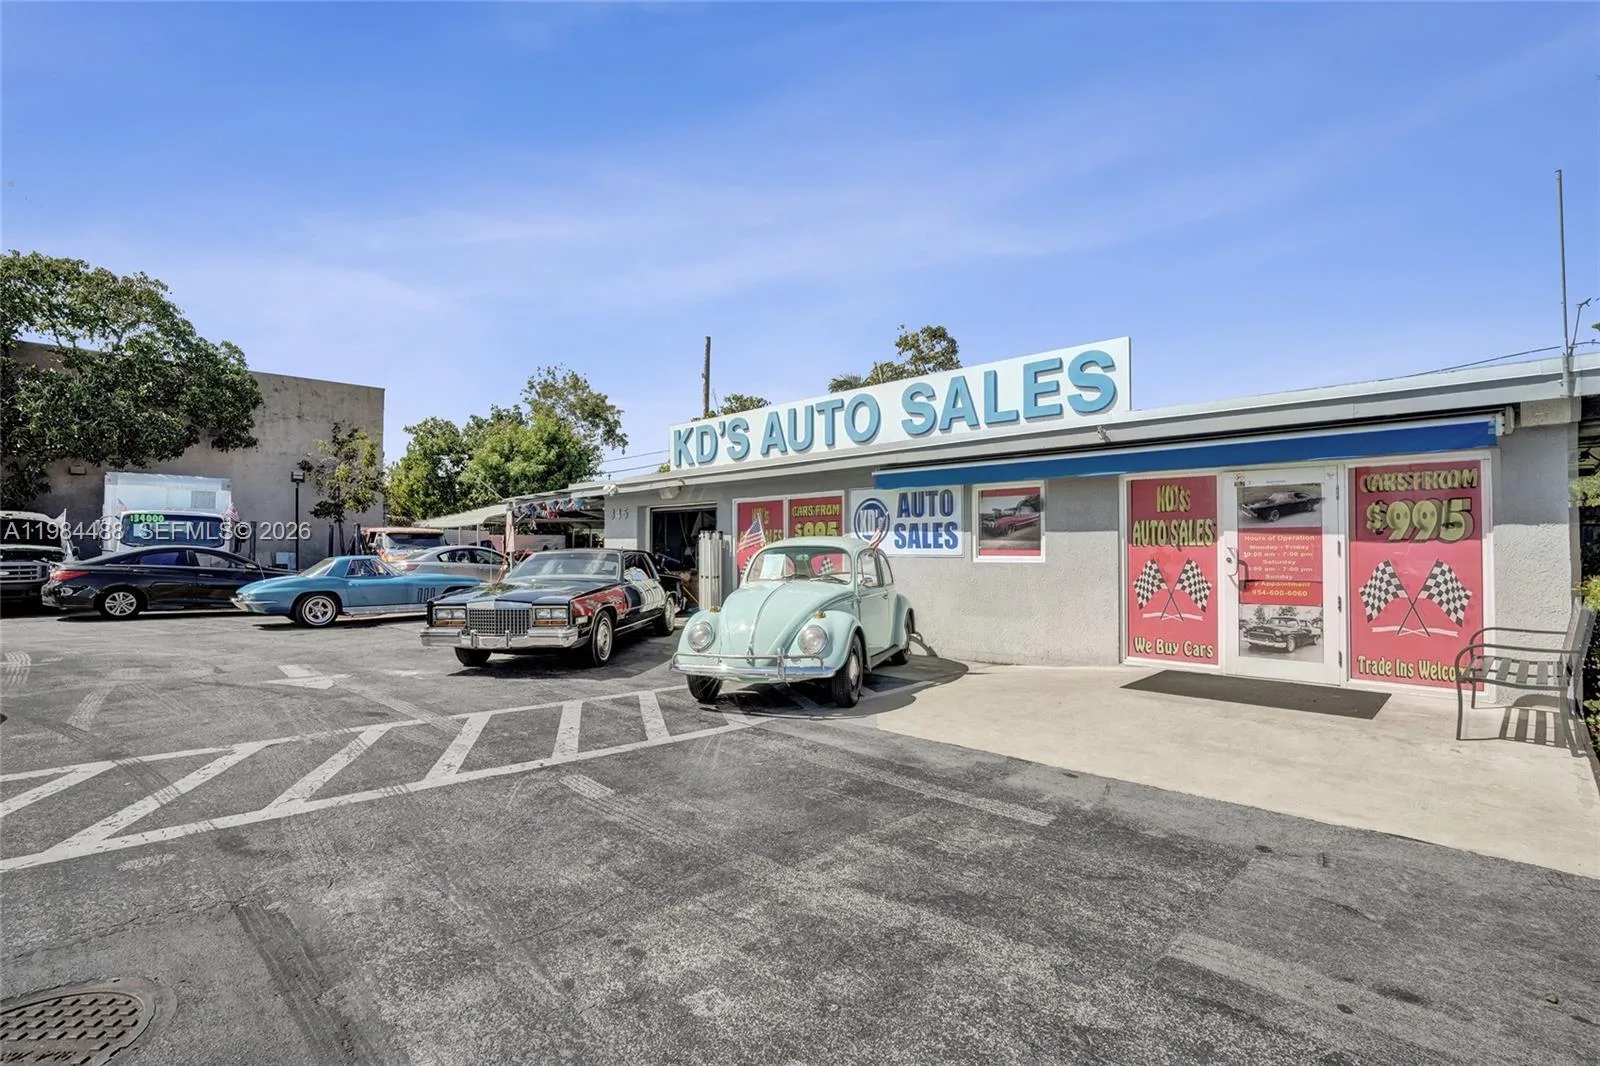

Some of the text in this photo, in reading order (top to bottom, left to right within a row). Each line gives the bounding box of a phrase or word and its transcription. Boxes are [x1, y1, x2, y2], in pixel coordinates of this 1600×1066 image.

[673, 350, 1118, 467] KD'S AUTO SALES
[792, 504, 840, 517] CARS FROM
[897, 489, 953, 518] AUTO
[1132, 518, 1216, 547] AUTO SALES
[1366, 497, 1475, 544] $995
[894, 521, 959, 549] SALES
[1278, 534, 1315, 542] Operation
[1263, 581, 1311, 589] Appointment
[1134, 636, 1214, 658] We Buy Cars
[1358, 656, 1393, 676] Trade
[1395, 659, 1415, 679] Ins
